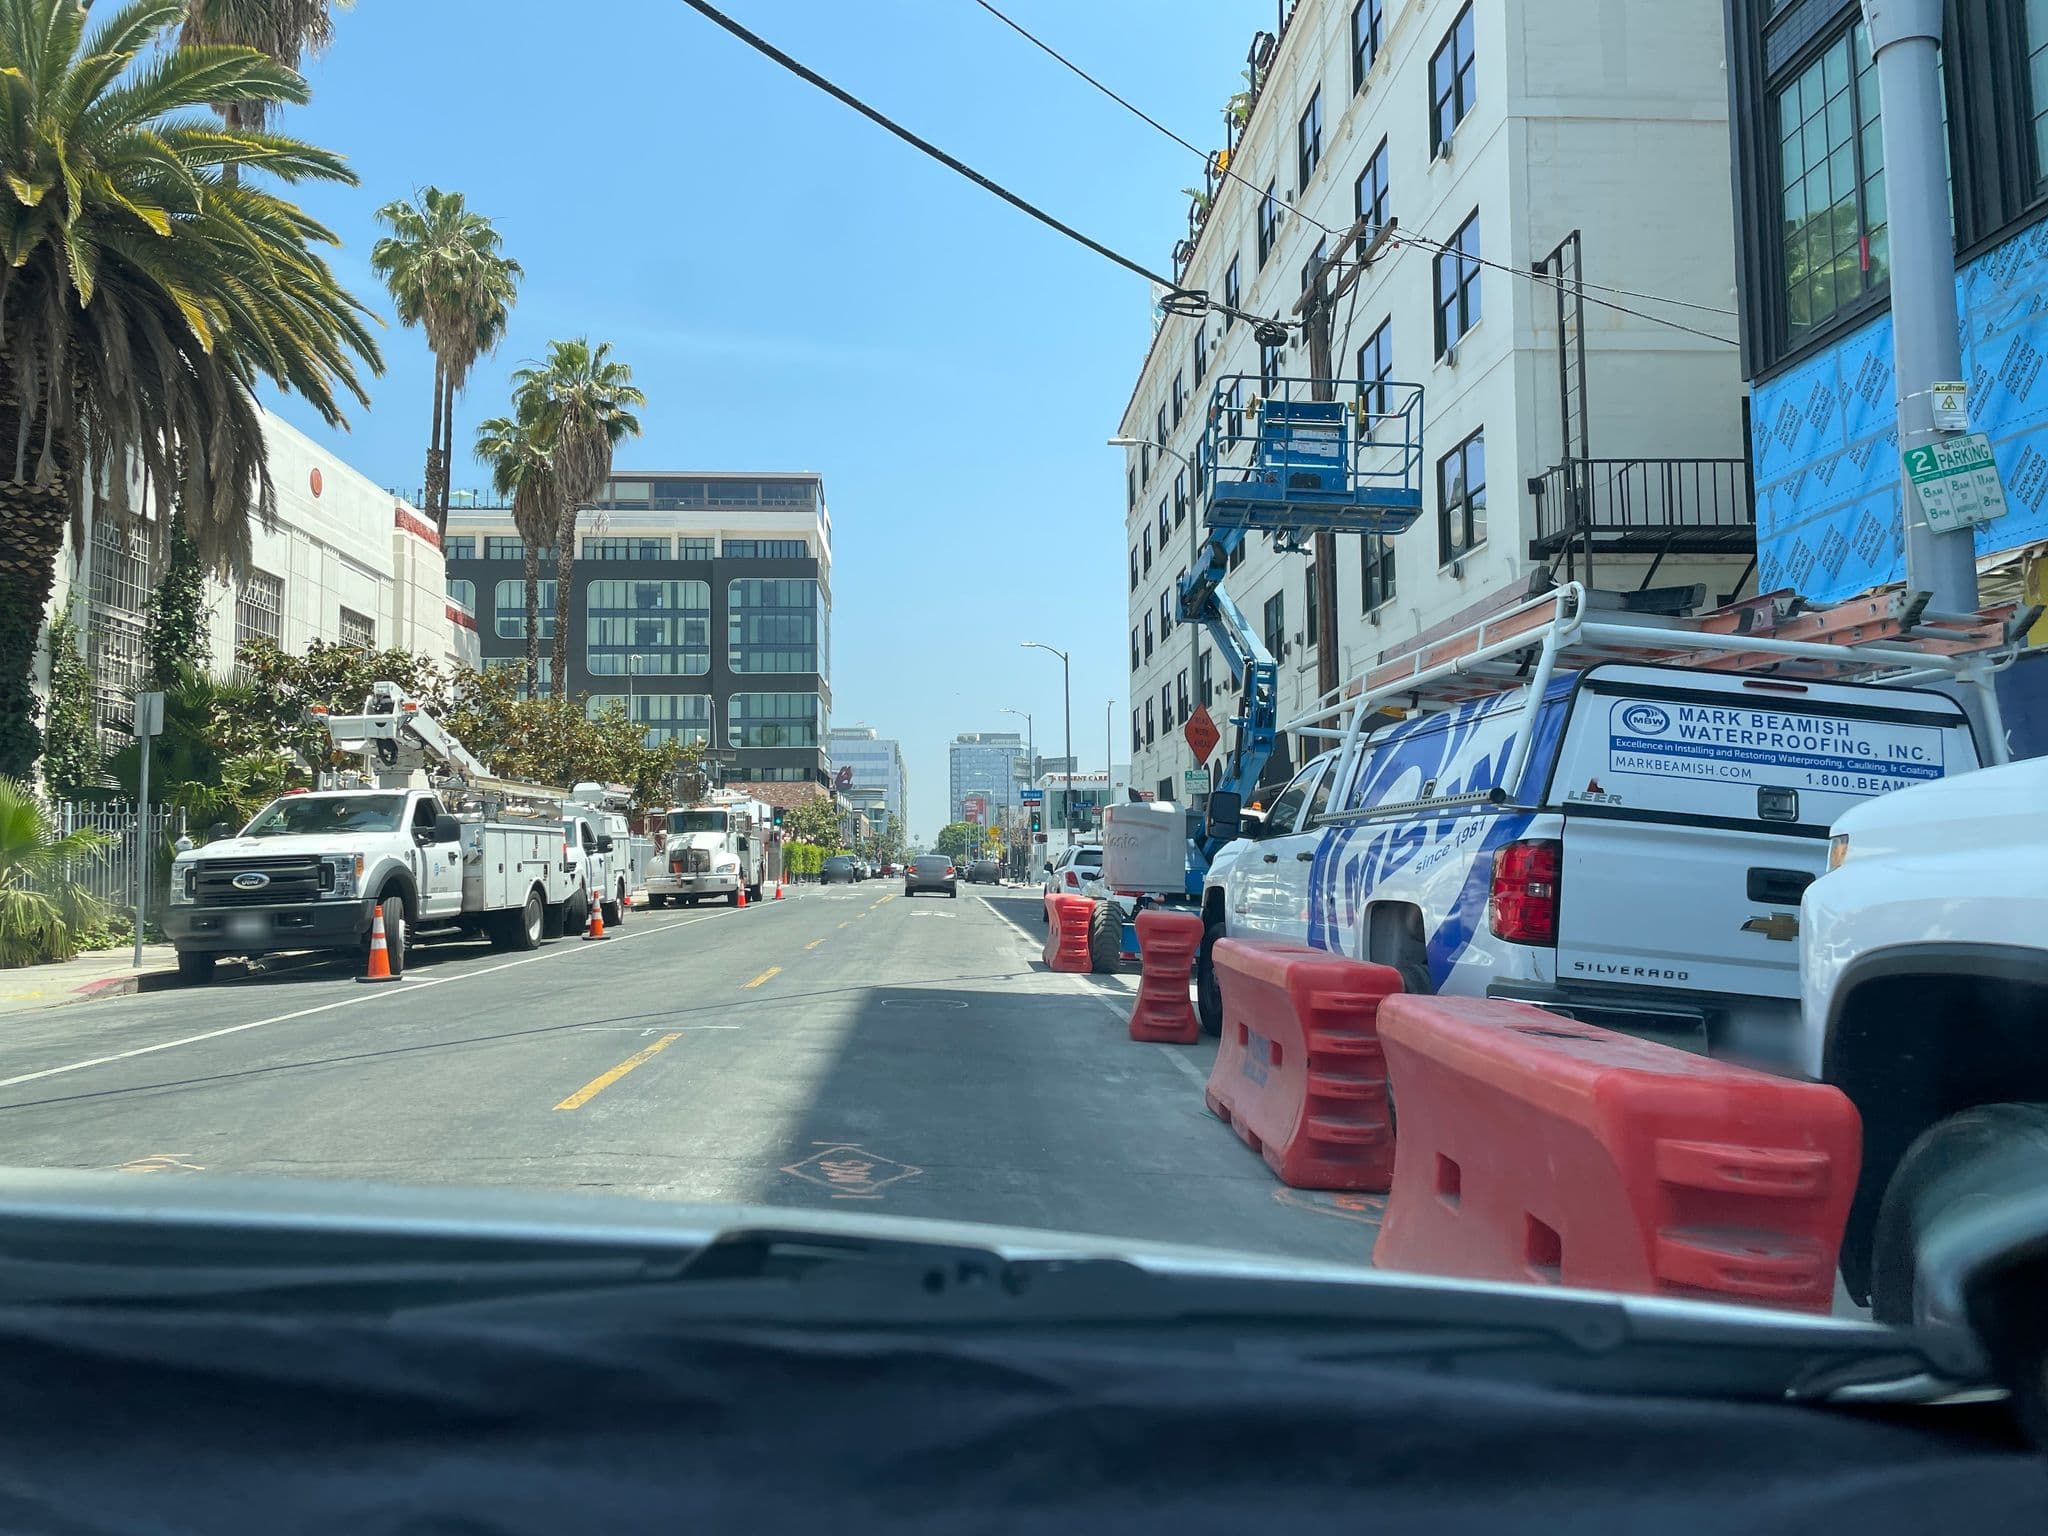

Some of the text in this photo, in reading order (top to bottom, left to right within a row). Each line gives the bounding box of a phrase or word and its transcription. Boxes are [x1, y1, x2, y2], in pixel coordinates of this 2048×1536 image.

[1911, 451, 1931, 472] 2
[1938, 444, 1989, 469] PARKING
[1633, 716, 1664, 726] MBW
[1679, 707, 1849, 736] MARK BEAMISH
[1679, 724, 1932, 761] WATERPROOFING, INC.
[1615, 756, 1752, 779] MARKBEAMISH.COM
[1616, 738, 1939, 777] Excellence in Installing and Restoring Waterproofing, Caulking, & Coatings
[1567, 790, 1623, 805] LEER
[1415, 815, 1487, 875] since 1981
[1574, 961, 1689, 982] SILVERADO
